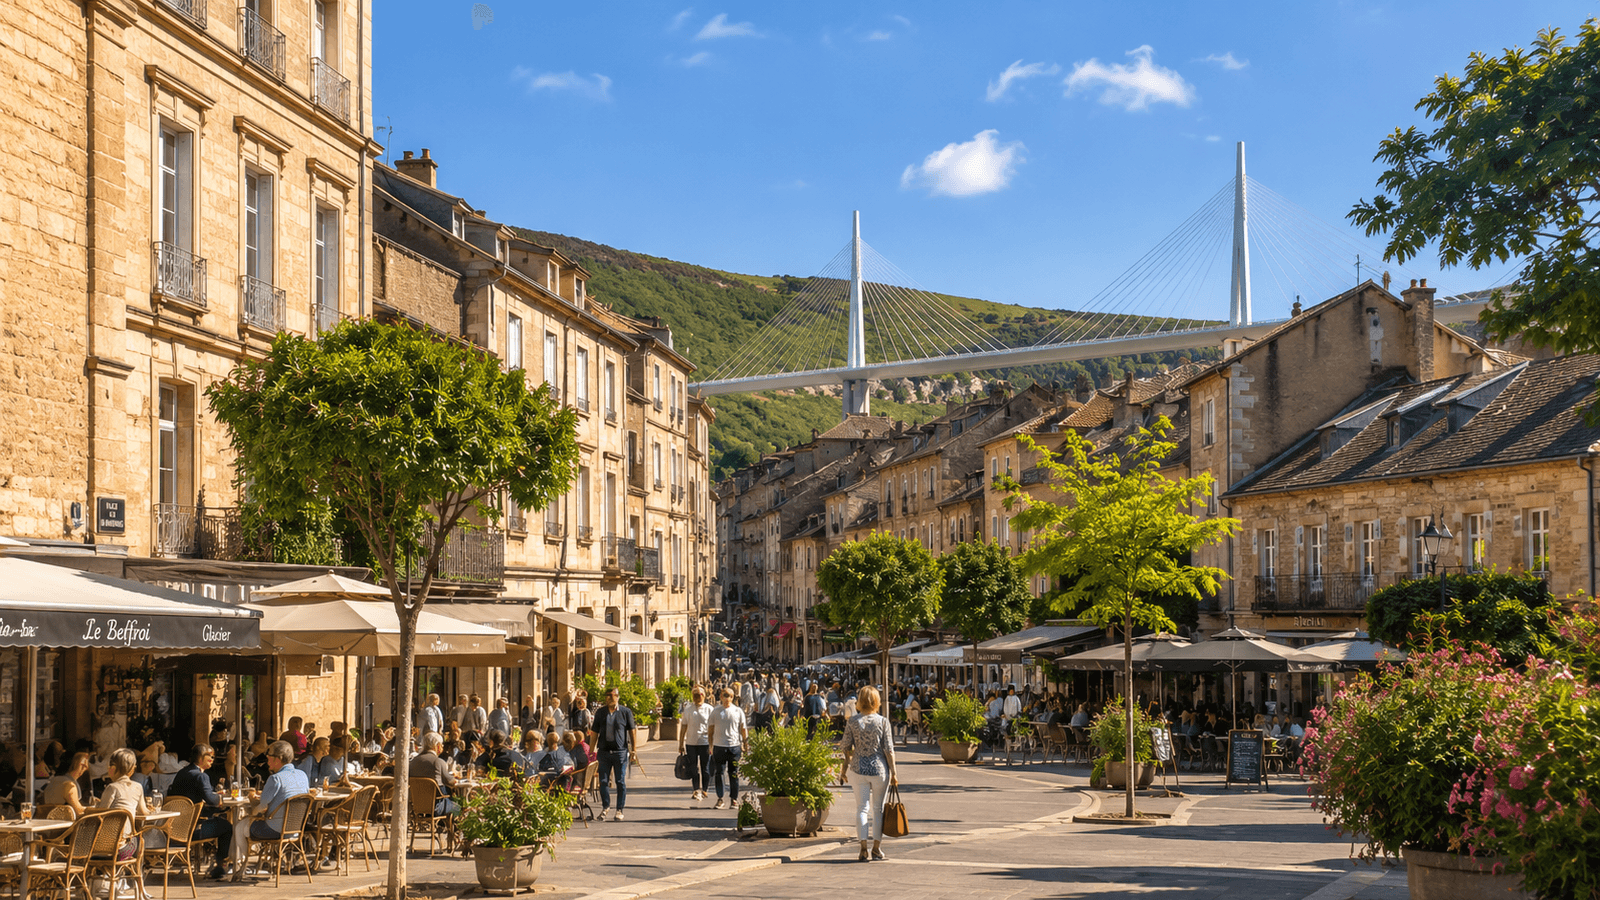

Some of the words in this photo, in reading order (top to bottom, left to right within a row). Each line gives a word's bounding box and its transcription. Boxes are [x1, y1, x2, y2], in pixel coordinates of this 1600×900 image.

[82, 618, 101, 640] Le
[107, 619, 150, 647] Beffroi
[202, 624, 231, 642] Glacier
